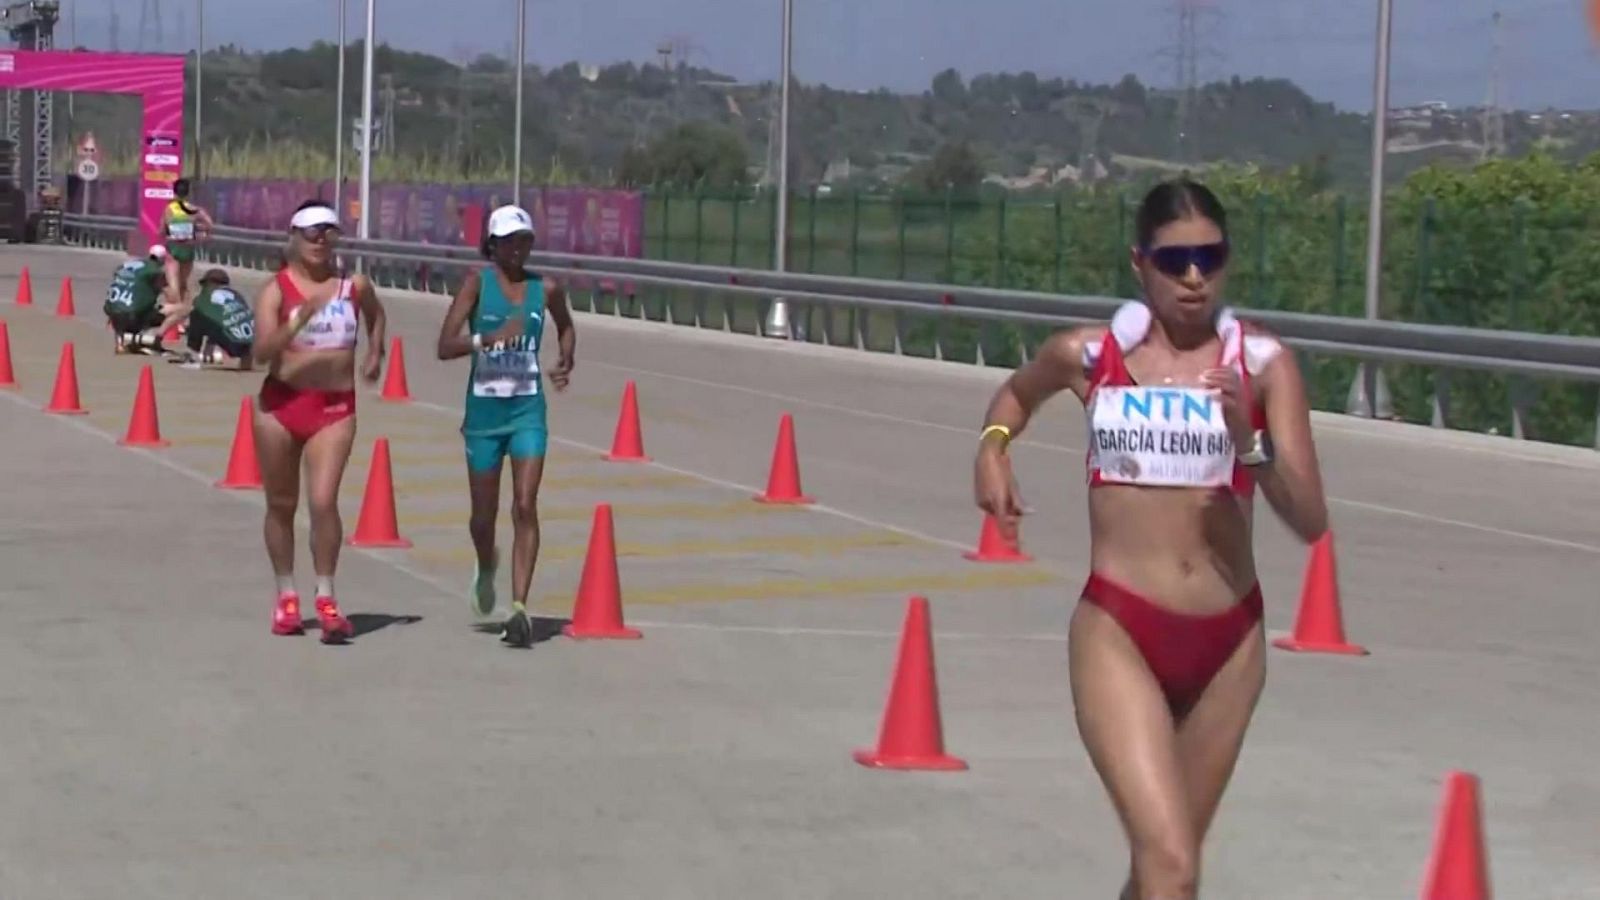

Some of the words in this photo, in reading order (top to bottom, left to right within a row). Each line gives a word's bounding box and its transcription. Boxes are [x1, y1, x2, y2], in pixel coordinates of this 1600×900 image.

[1122, 390, 1211, 422] NTN
[1098, 421, 1156, 453] GARCÍA
[1160, 424, 1203, 456] LEÓN
